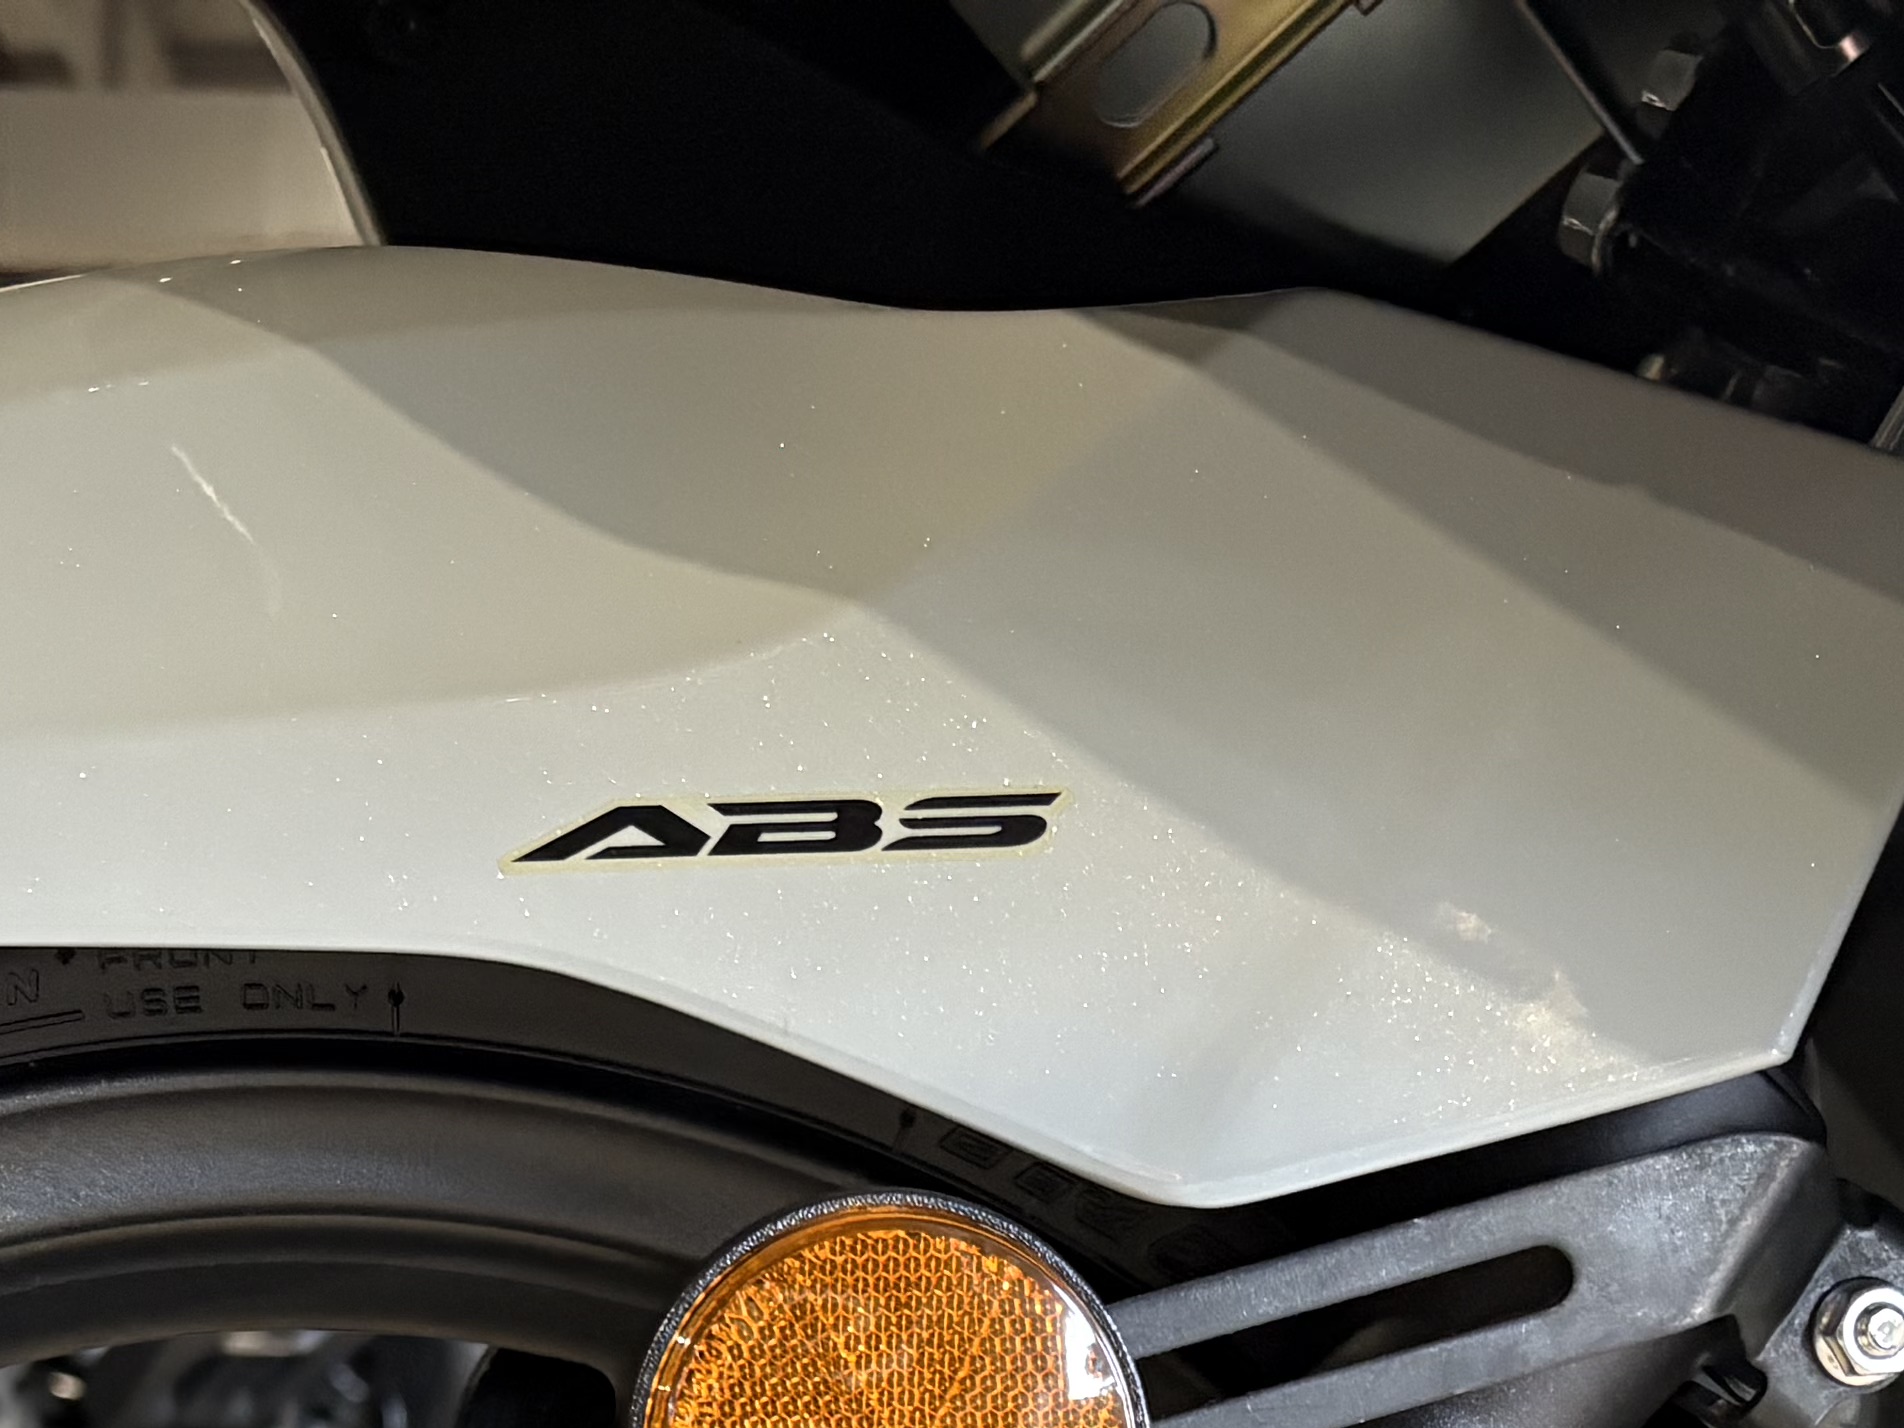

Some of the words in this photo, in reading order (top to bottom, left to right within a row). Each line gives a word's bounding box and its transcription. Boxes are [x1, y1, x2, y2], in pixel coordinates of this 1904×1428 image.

[512, 792, 1063, 863] ABS
[103, 982, 204, 1020] USE
[240, 980, 369, 1013] ONLY
